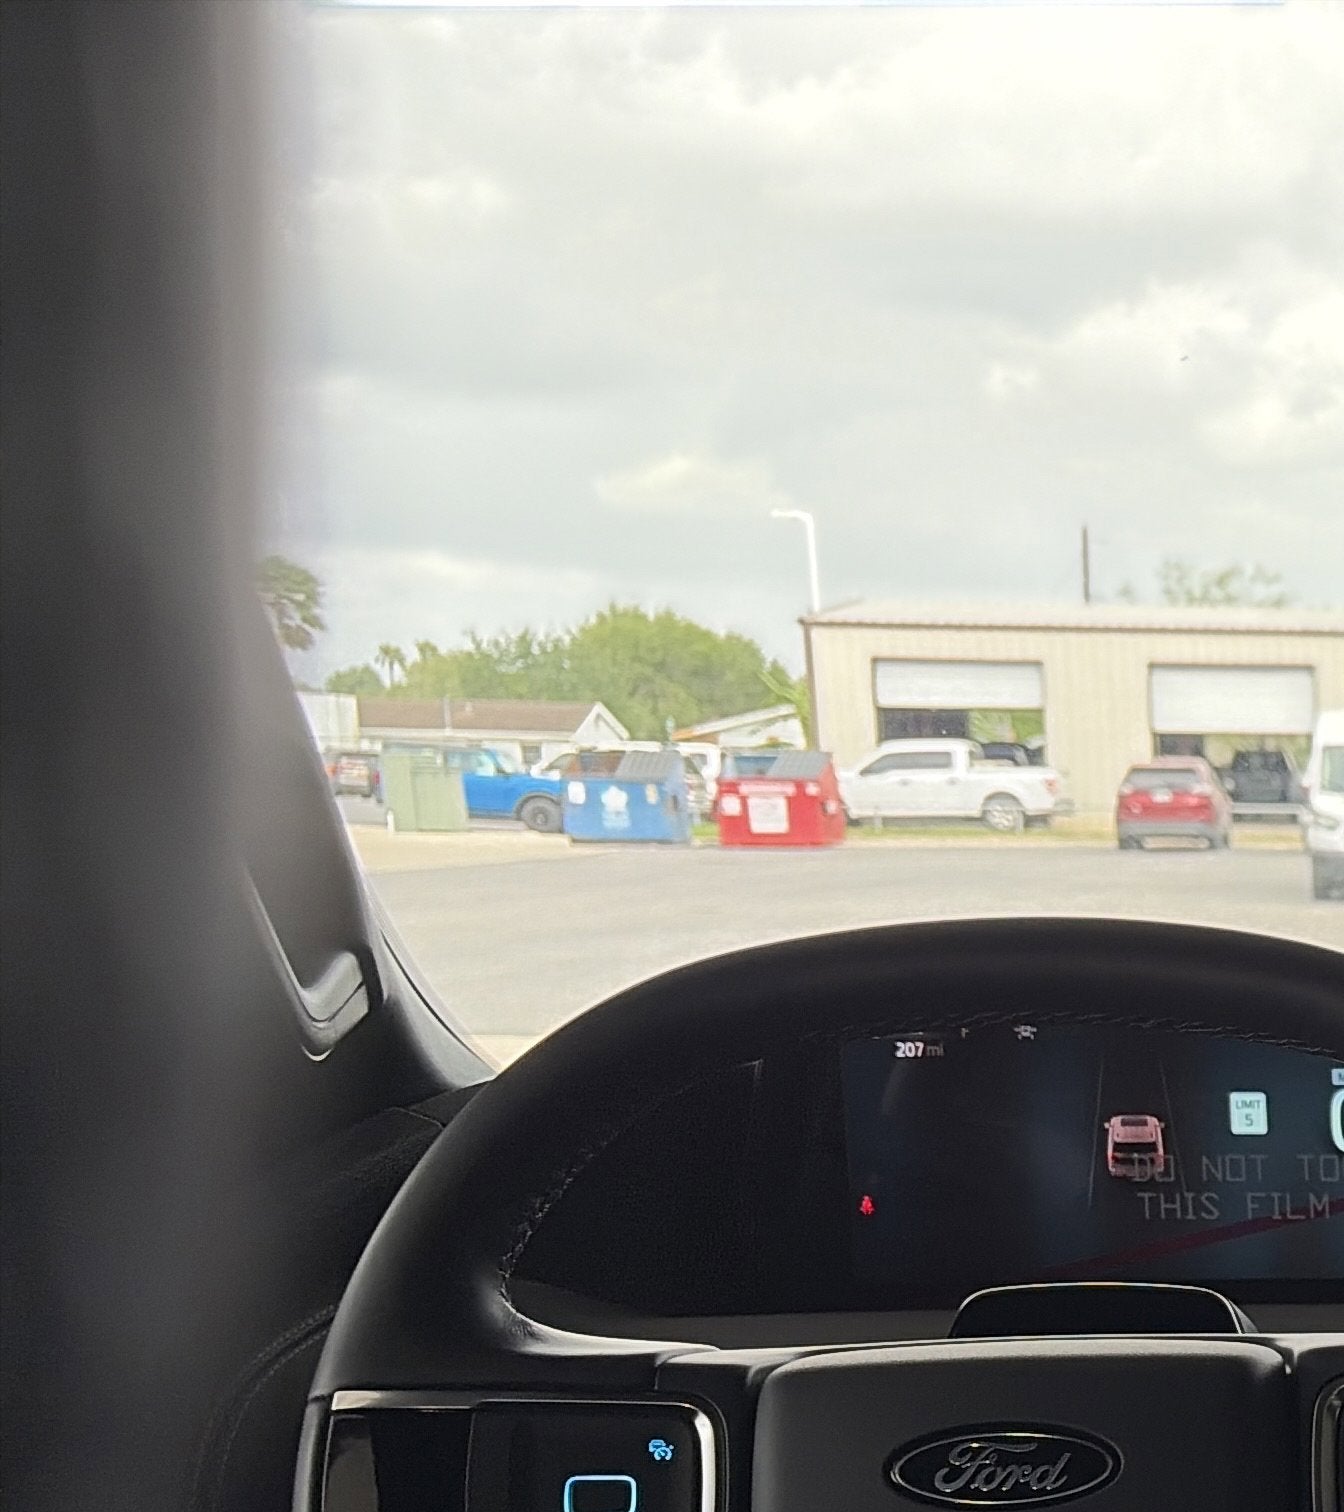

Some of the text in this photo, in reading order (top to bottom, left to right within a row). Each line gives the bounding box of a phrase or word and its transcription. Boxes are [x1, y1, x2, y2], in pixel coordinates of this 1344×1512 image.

[894, 1041, 945, 1058] 207 mi
[1235, 1100, 1262, 1110] LIMIT
[1132, 1154, 1175, 1183] DO
[1201, 1154, 1268, 1183] NOT
[1137, 1192, 1220, 1220] THIS
[1246, 1192, 1330, 1220] FILM
[933, 1440, 1069, 1493] Ford
